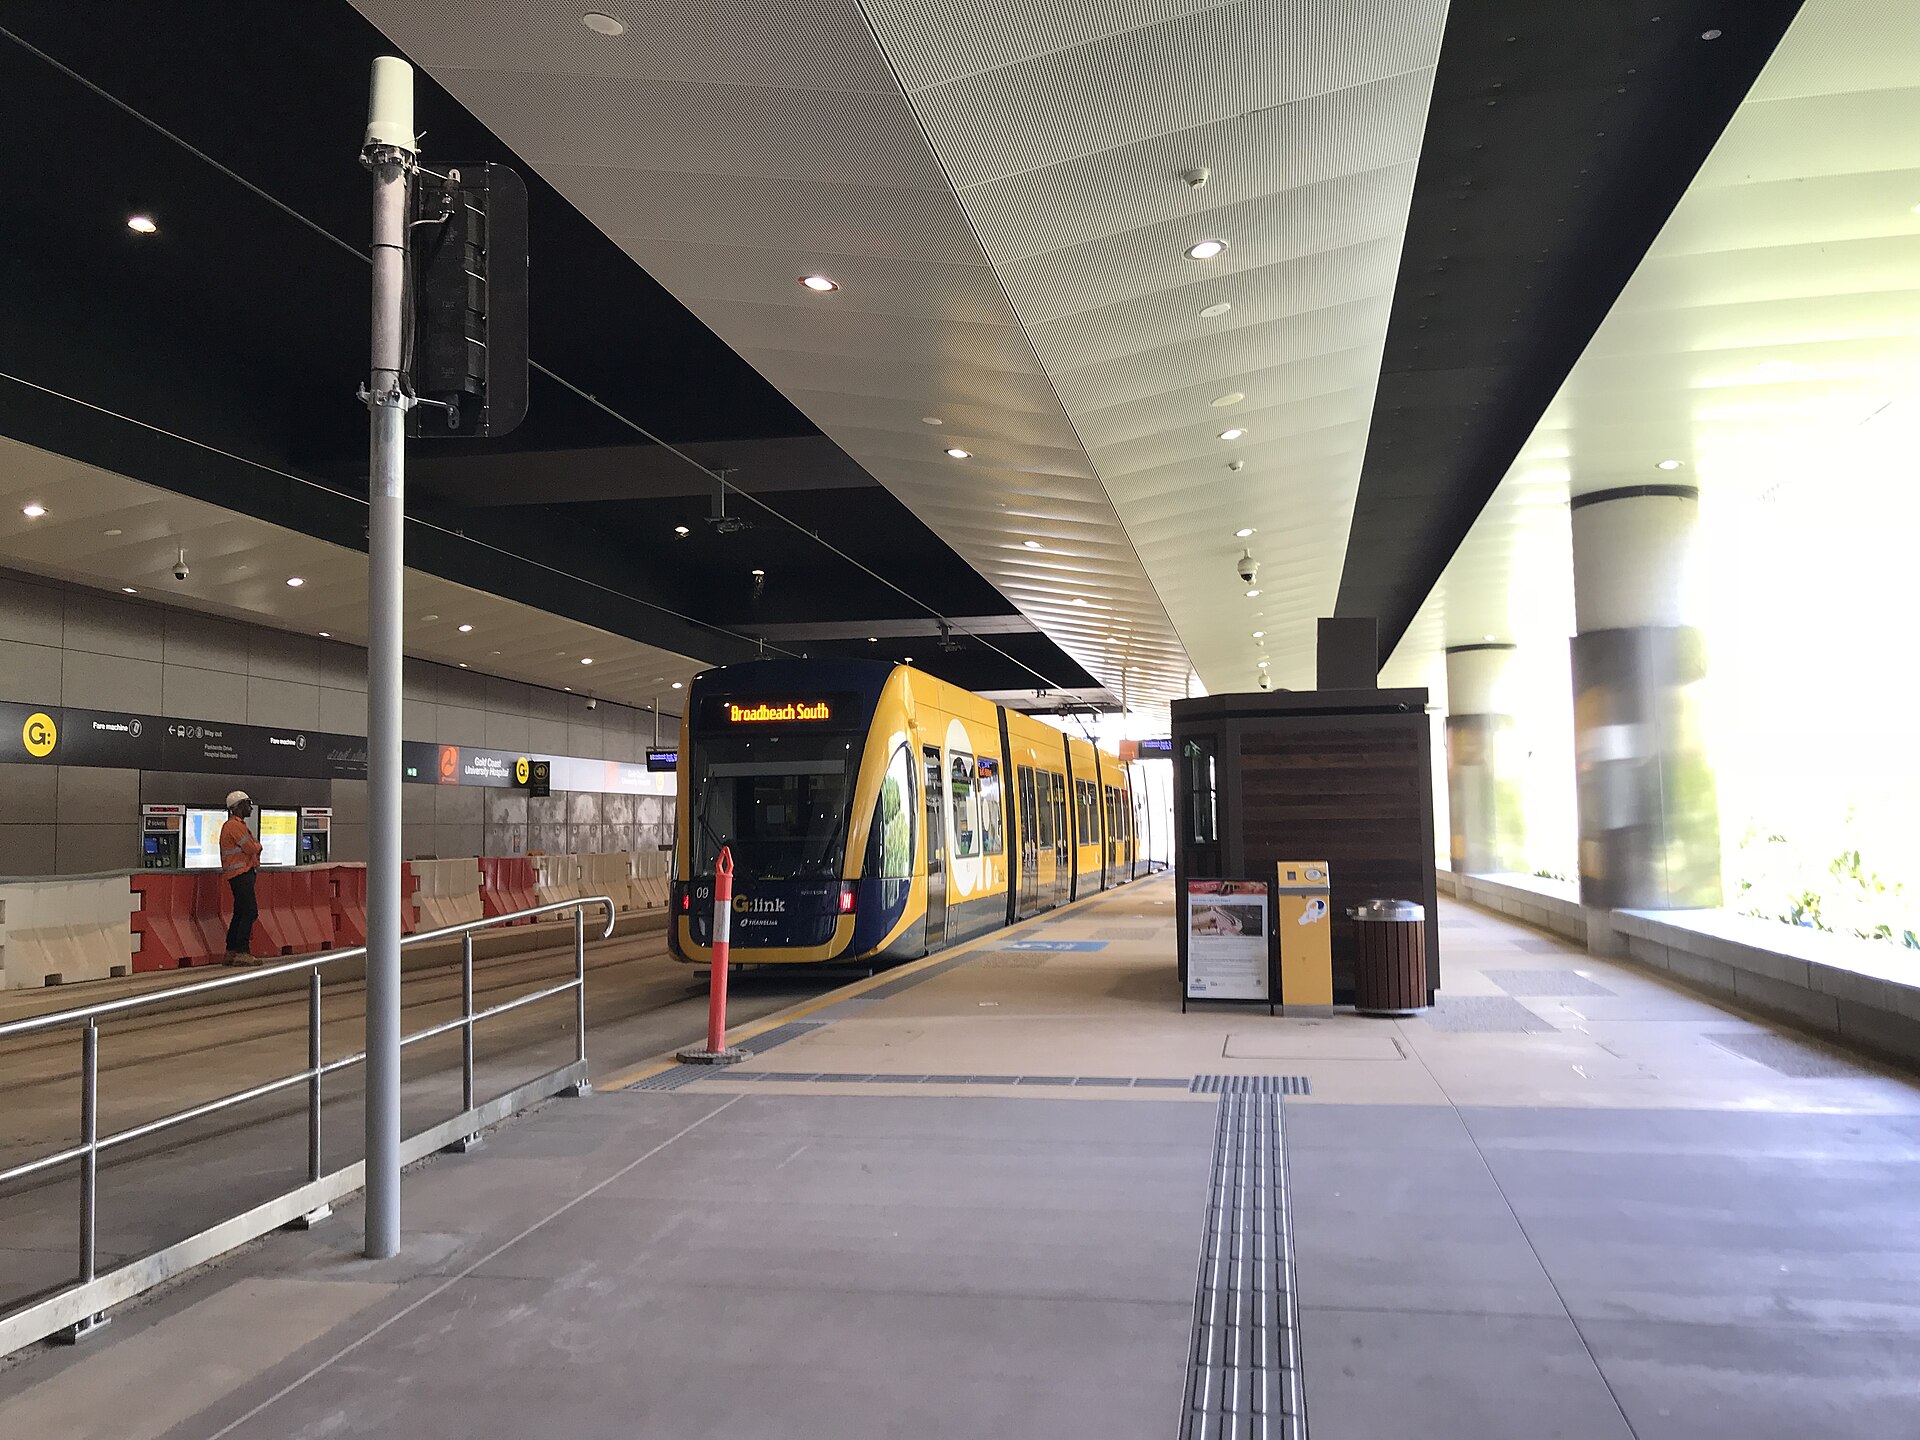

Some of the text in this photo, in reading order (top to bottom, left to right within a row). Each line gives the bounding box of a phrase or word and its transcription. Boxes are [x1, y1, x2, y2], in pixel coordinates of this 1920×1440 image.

[731, 702, 829, 721] Broadbeach South
[92, 721, 128, 732] Fare machine
[474, 757, 501, 768] Gold Coast
[465, 765, 509, 779] University Hospital
[696, 887, 709, 899] 09
[733, 894, 786, 913] G:link
